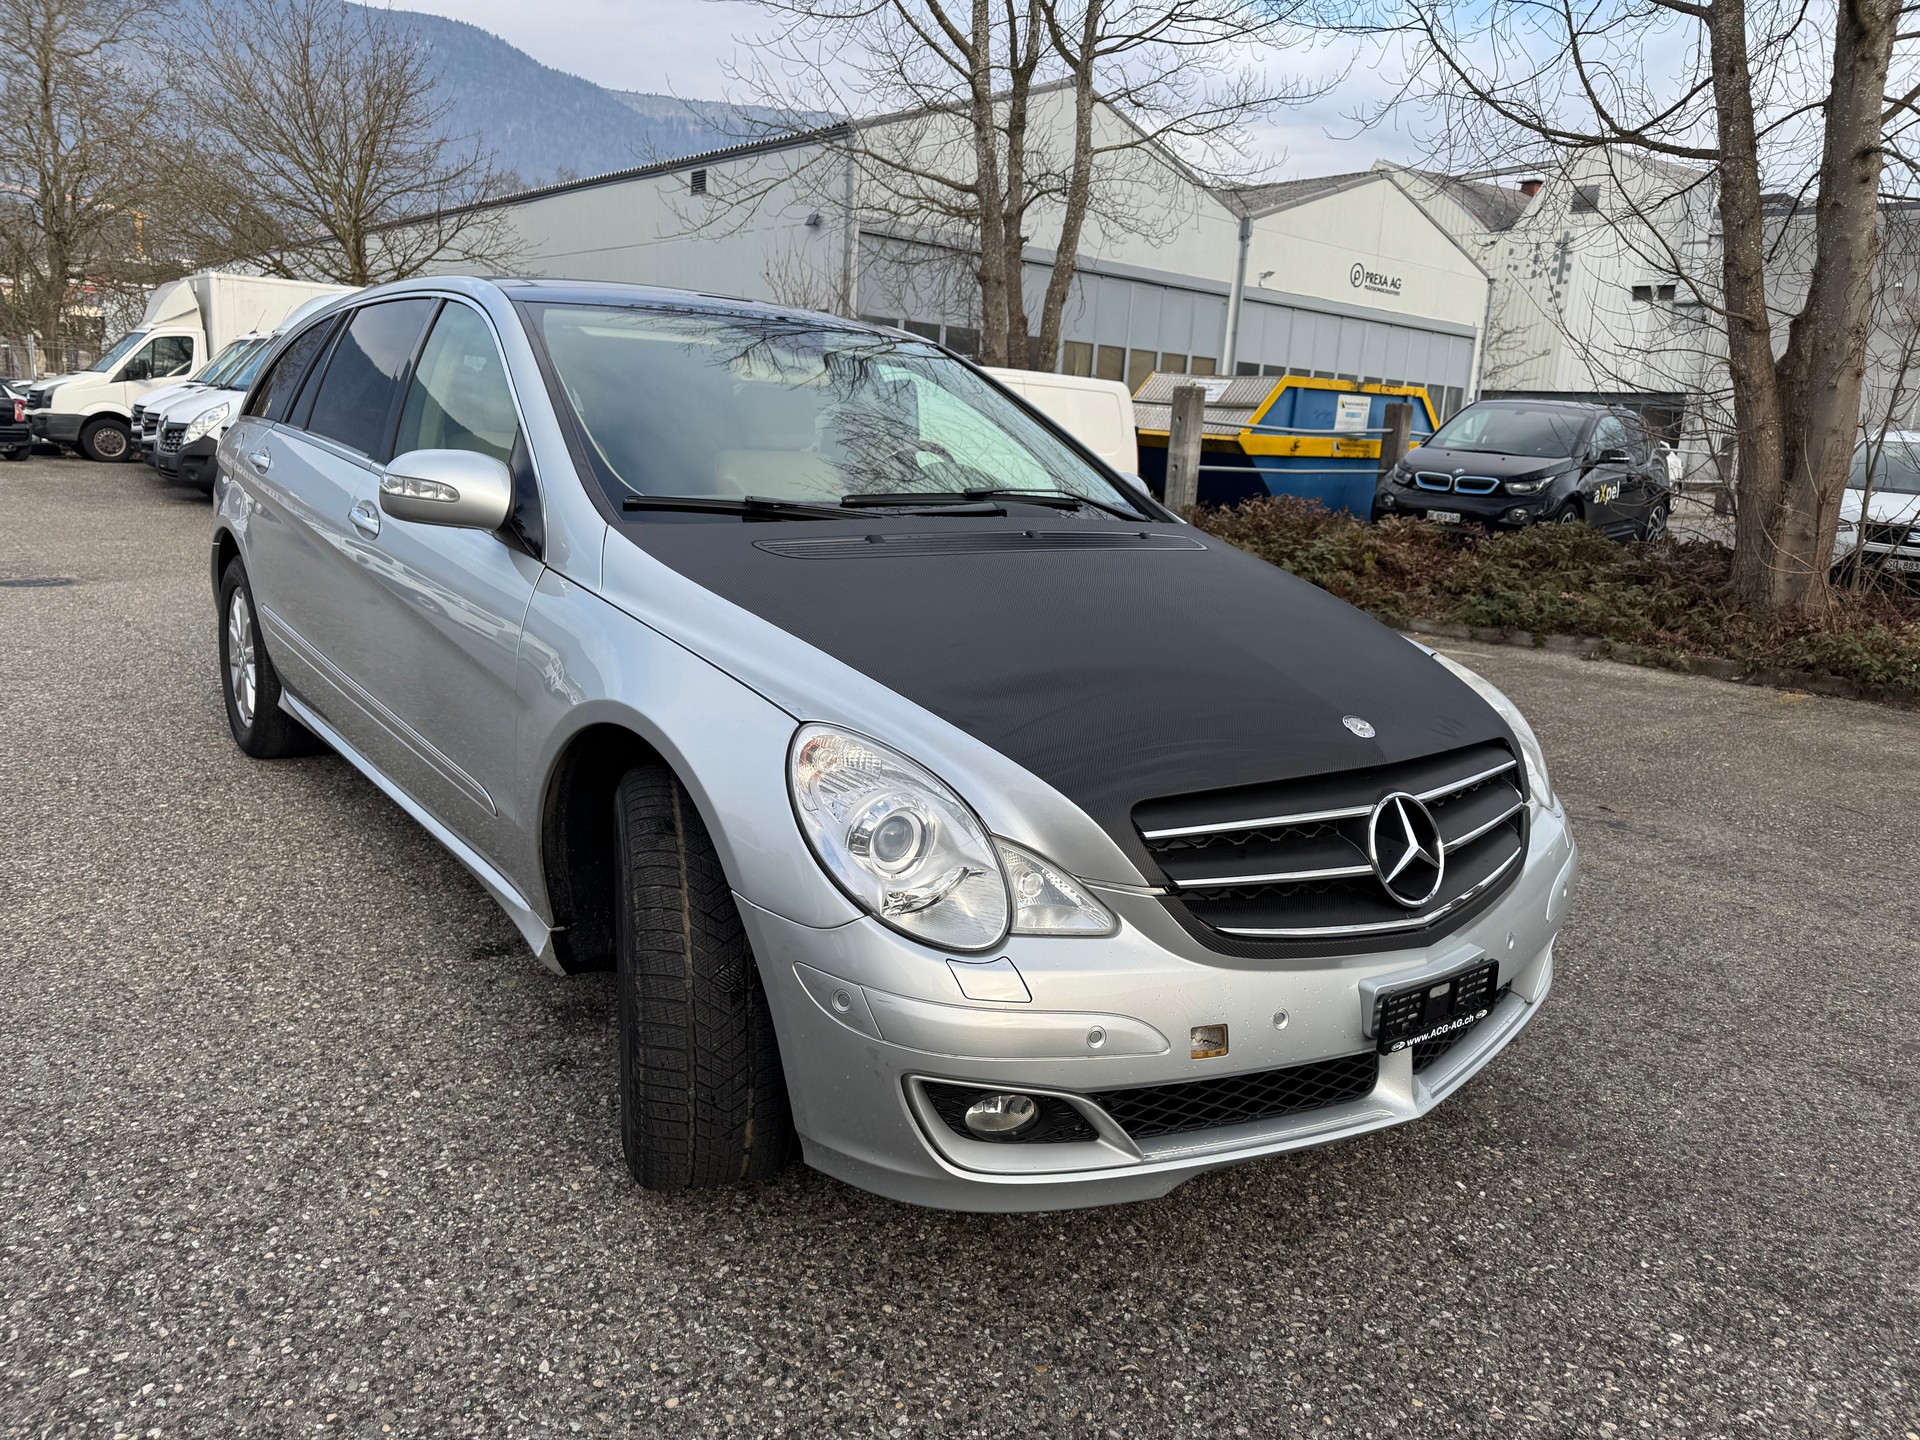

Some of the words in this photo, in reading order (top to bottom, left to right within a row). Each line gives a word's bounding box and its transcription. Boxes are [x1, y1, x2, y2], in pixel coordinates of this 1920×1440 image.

[1365, 271, 1388, 287] PREXA
[1389, 277, 1402, 290] AG
[1902, 561, 1920, 571] 883
[1406, 1014, 1474, 1047] www.ACG-AG.ch
